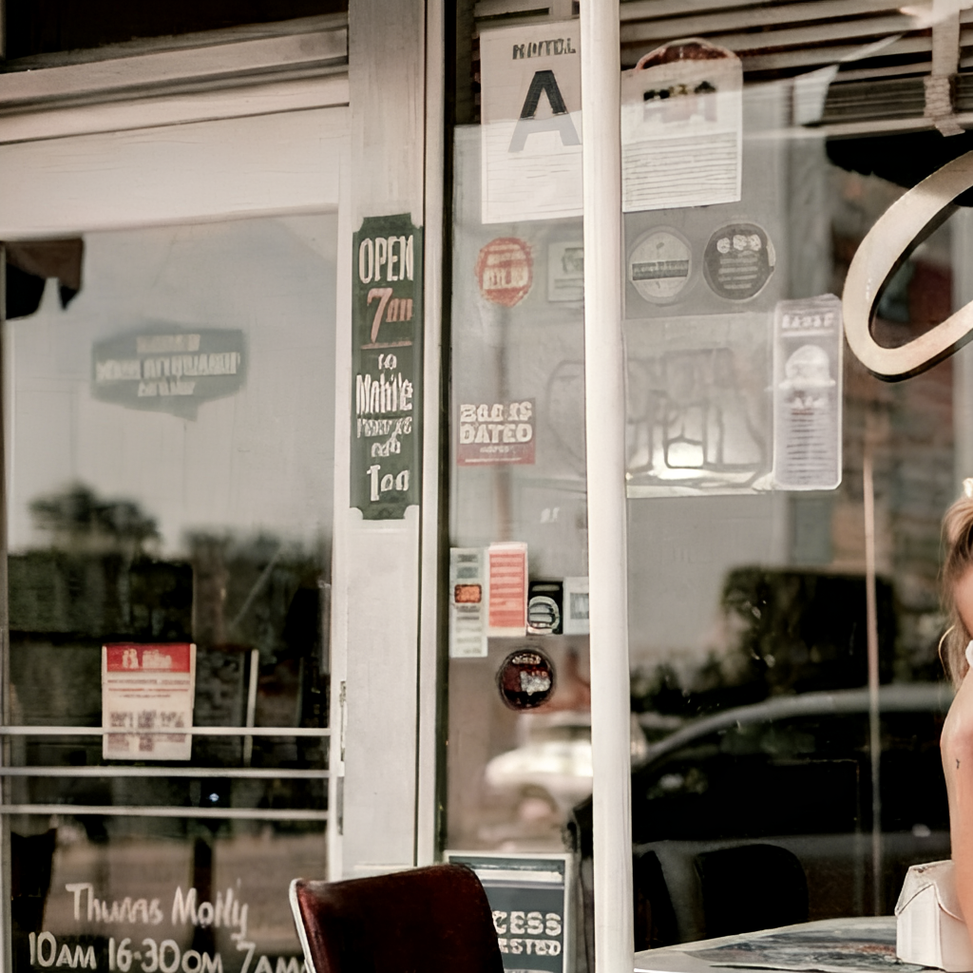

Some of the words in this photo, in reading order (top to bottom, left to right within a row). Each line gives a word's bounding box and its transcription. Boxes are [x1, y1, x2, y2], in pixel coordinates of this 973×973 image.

[508, 70, 582, 153] A
[358, 235, 414, 284] OPEN
[28, 931, 98, 969] 10AM
